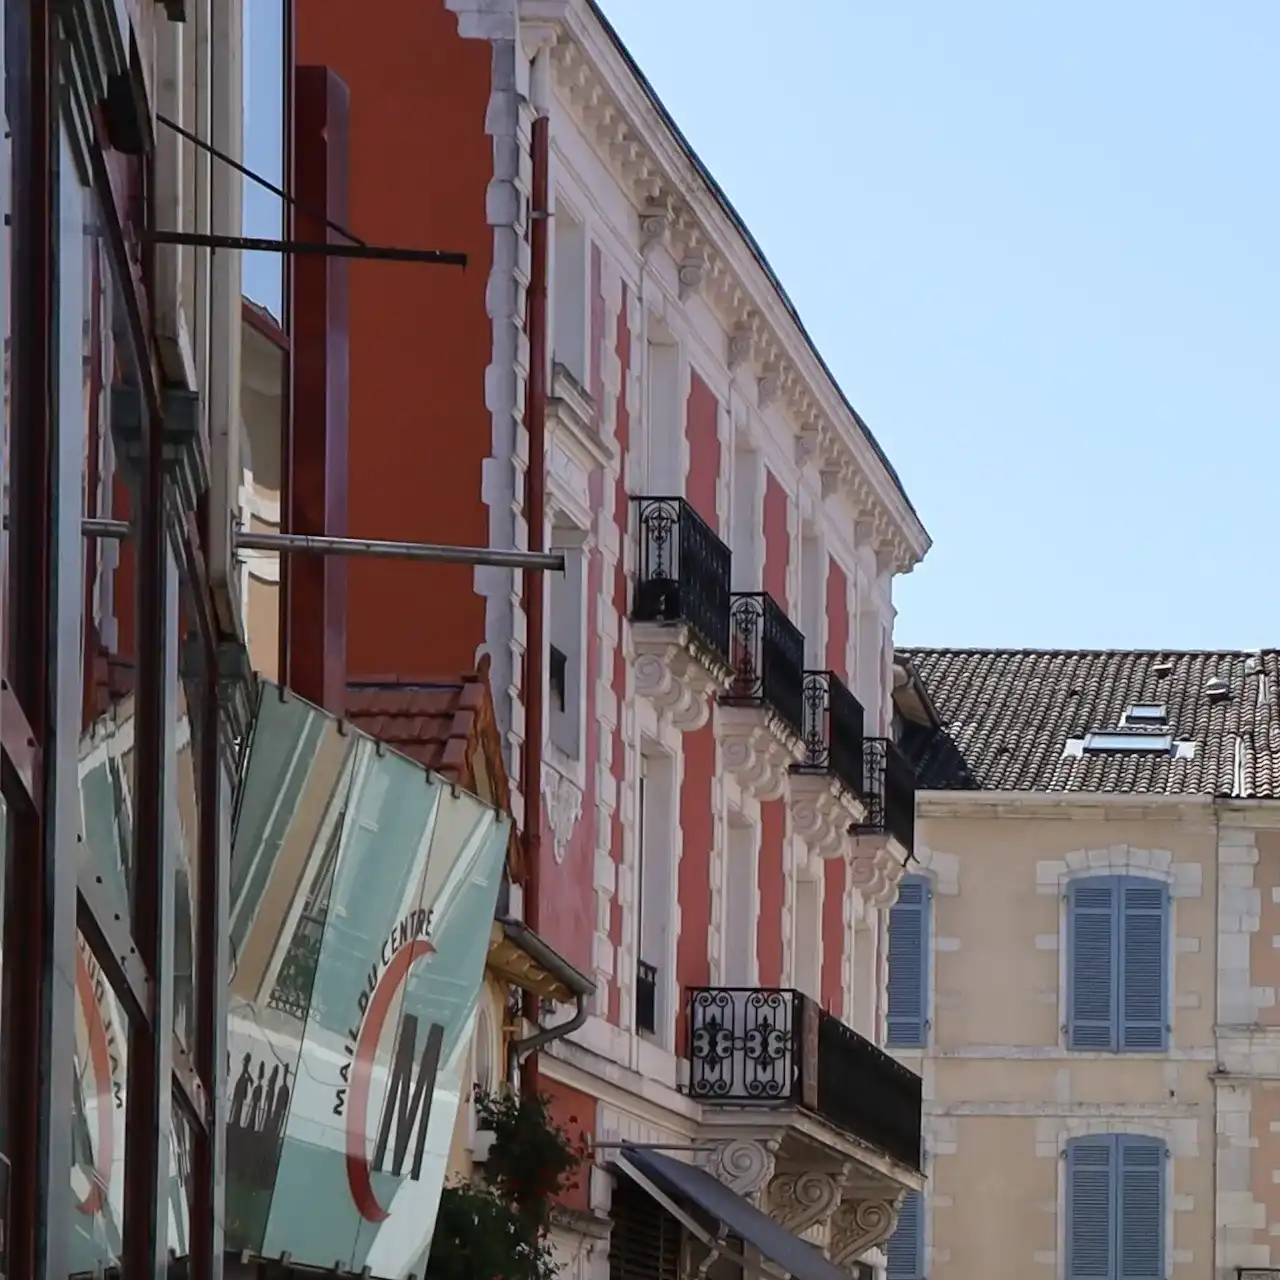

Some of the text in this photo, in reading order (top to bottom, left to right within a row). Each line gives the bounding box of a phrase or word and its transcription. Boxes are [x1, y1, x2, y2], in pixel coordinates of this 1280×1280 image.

[333, 908, 434, 1116] MAIL DU CENTRE
